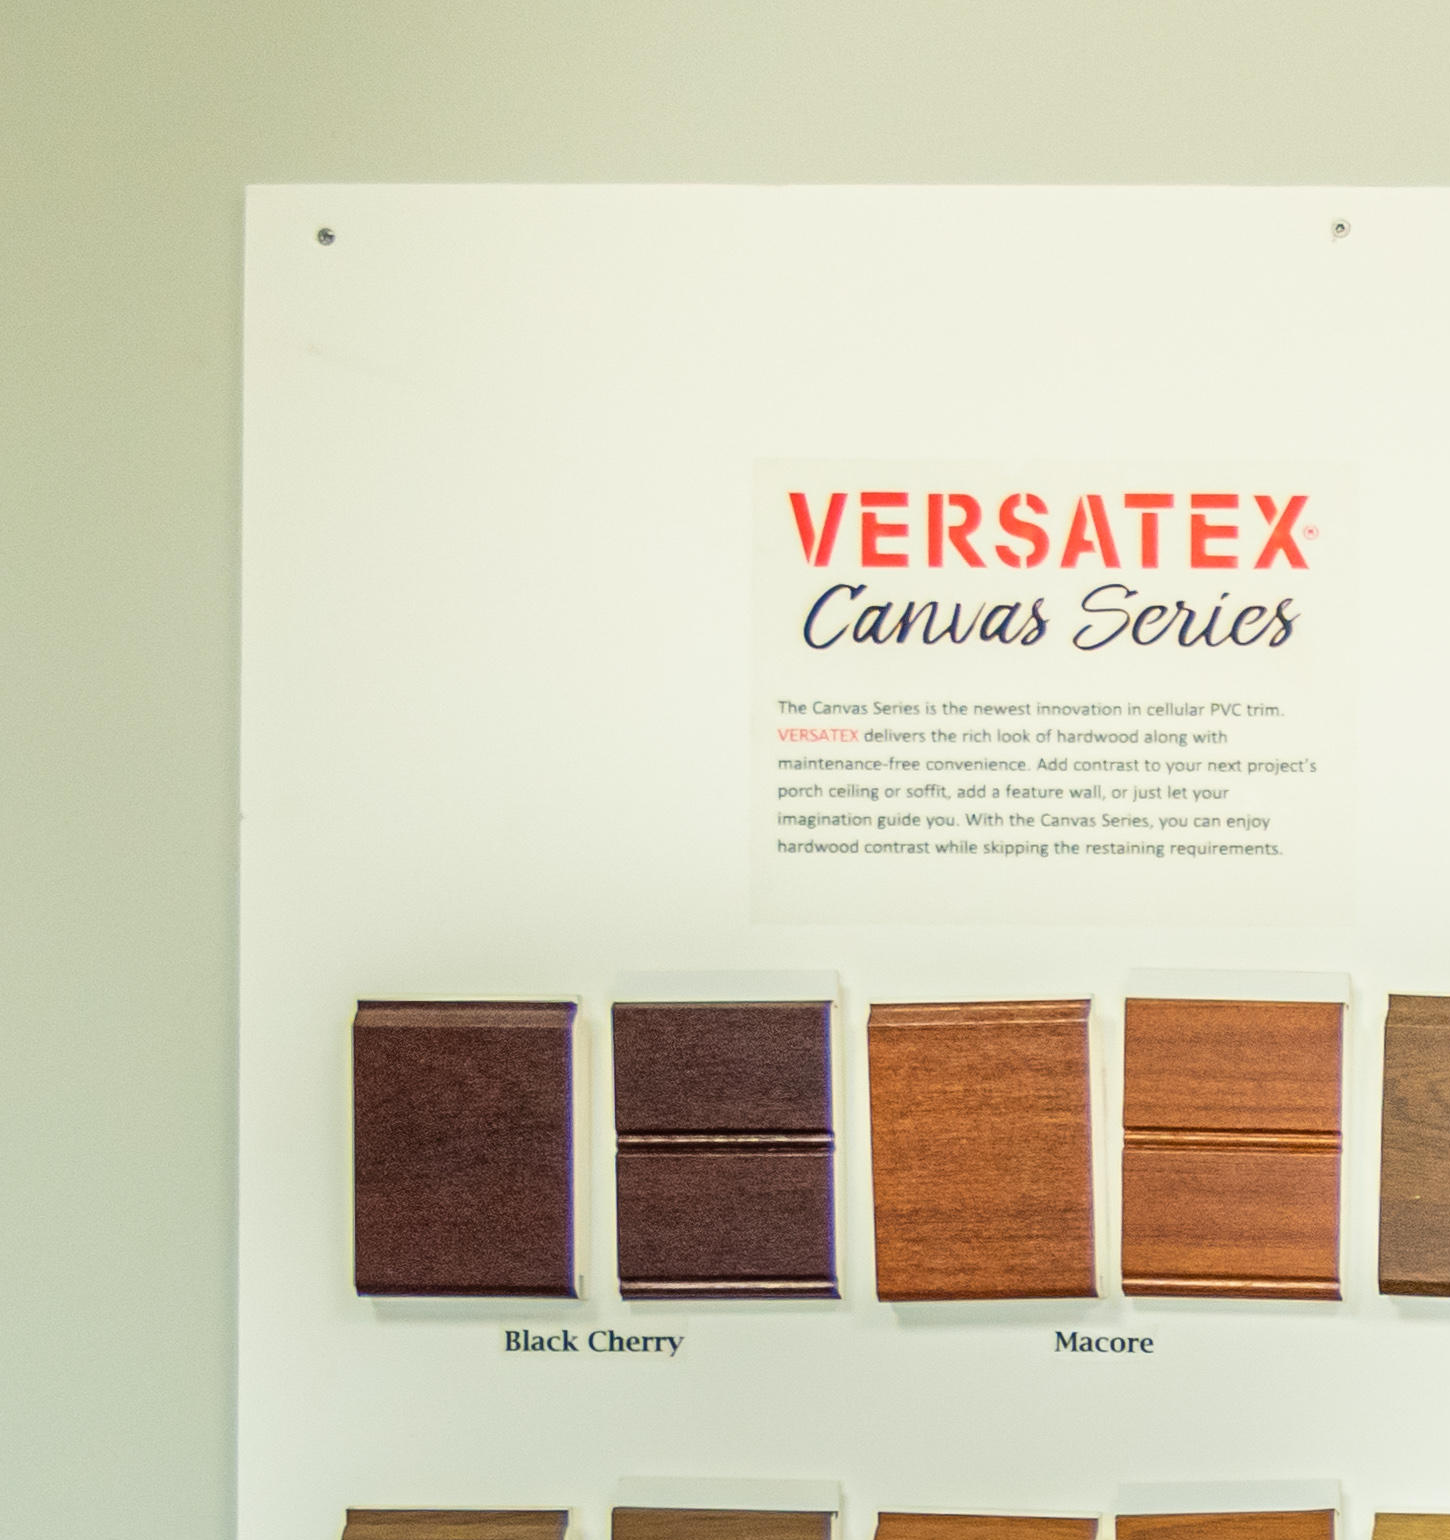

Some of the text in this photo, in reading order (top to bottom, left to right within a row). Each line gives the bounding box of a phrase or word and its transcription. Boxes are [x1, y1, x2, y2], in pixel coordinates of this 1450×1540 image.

[789, 492, 1310, 568] VERSATEX
[803, 583, 1302, 652] Canvas Series
[778, 701, 1284, 717] The Canvas Series is the newest innovation in cellular PVC trim.
[505, 1330, 684, 1357] Black Cherry
[1056, 1331, 1153, 1353] Macore
